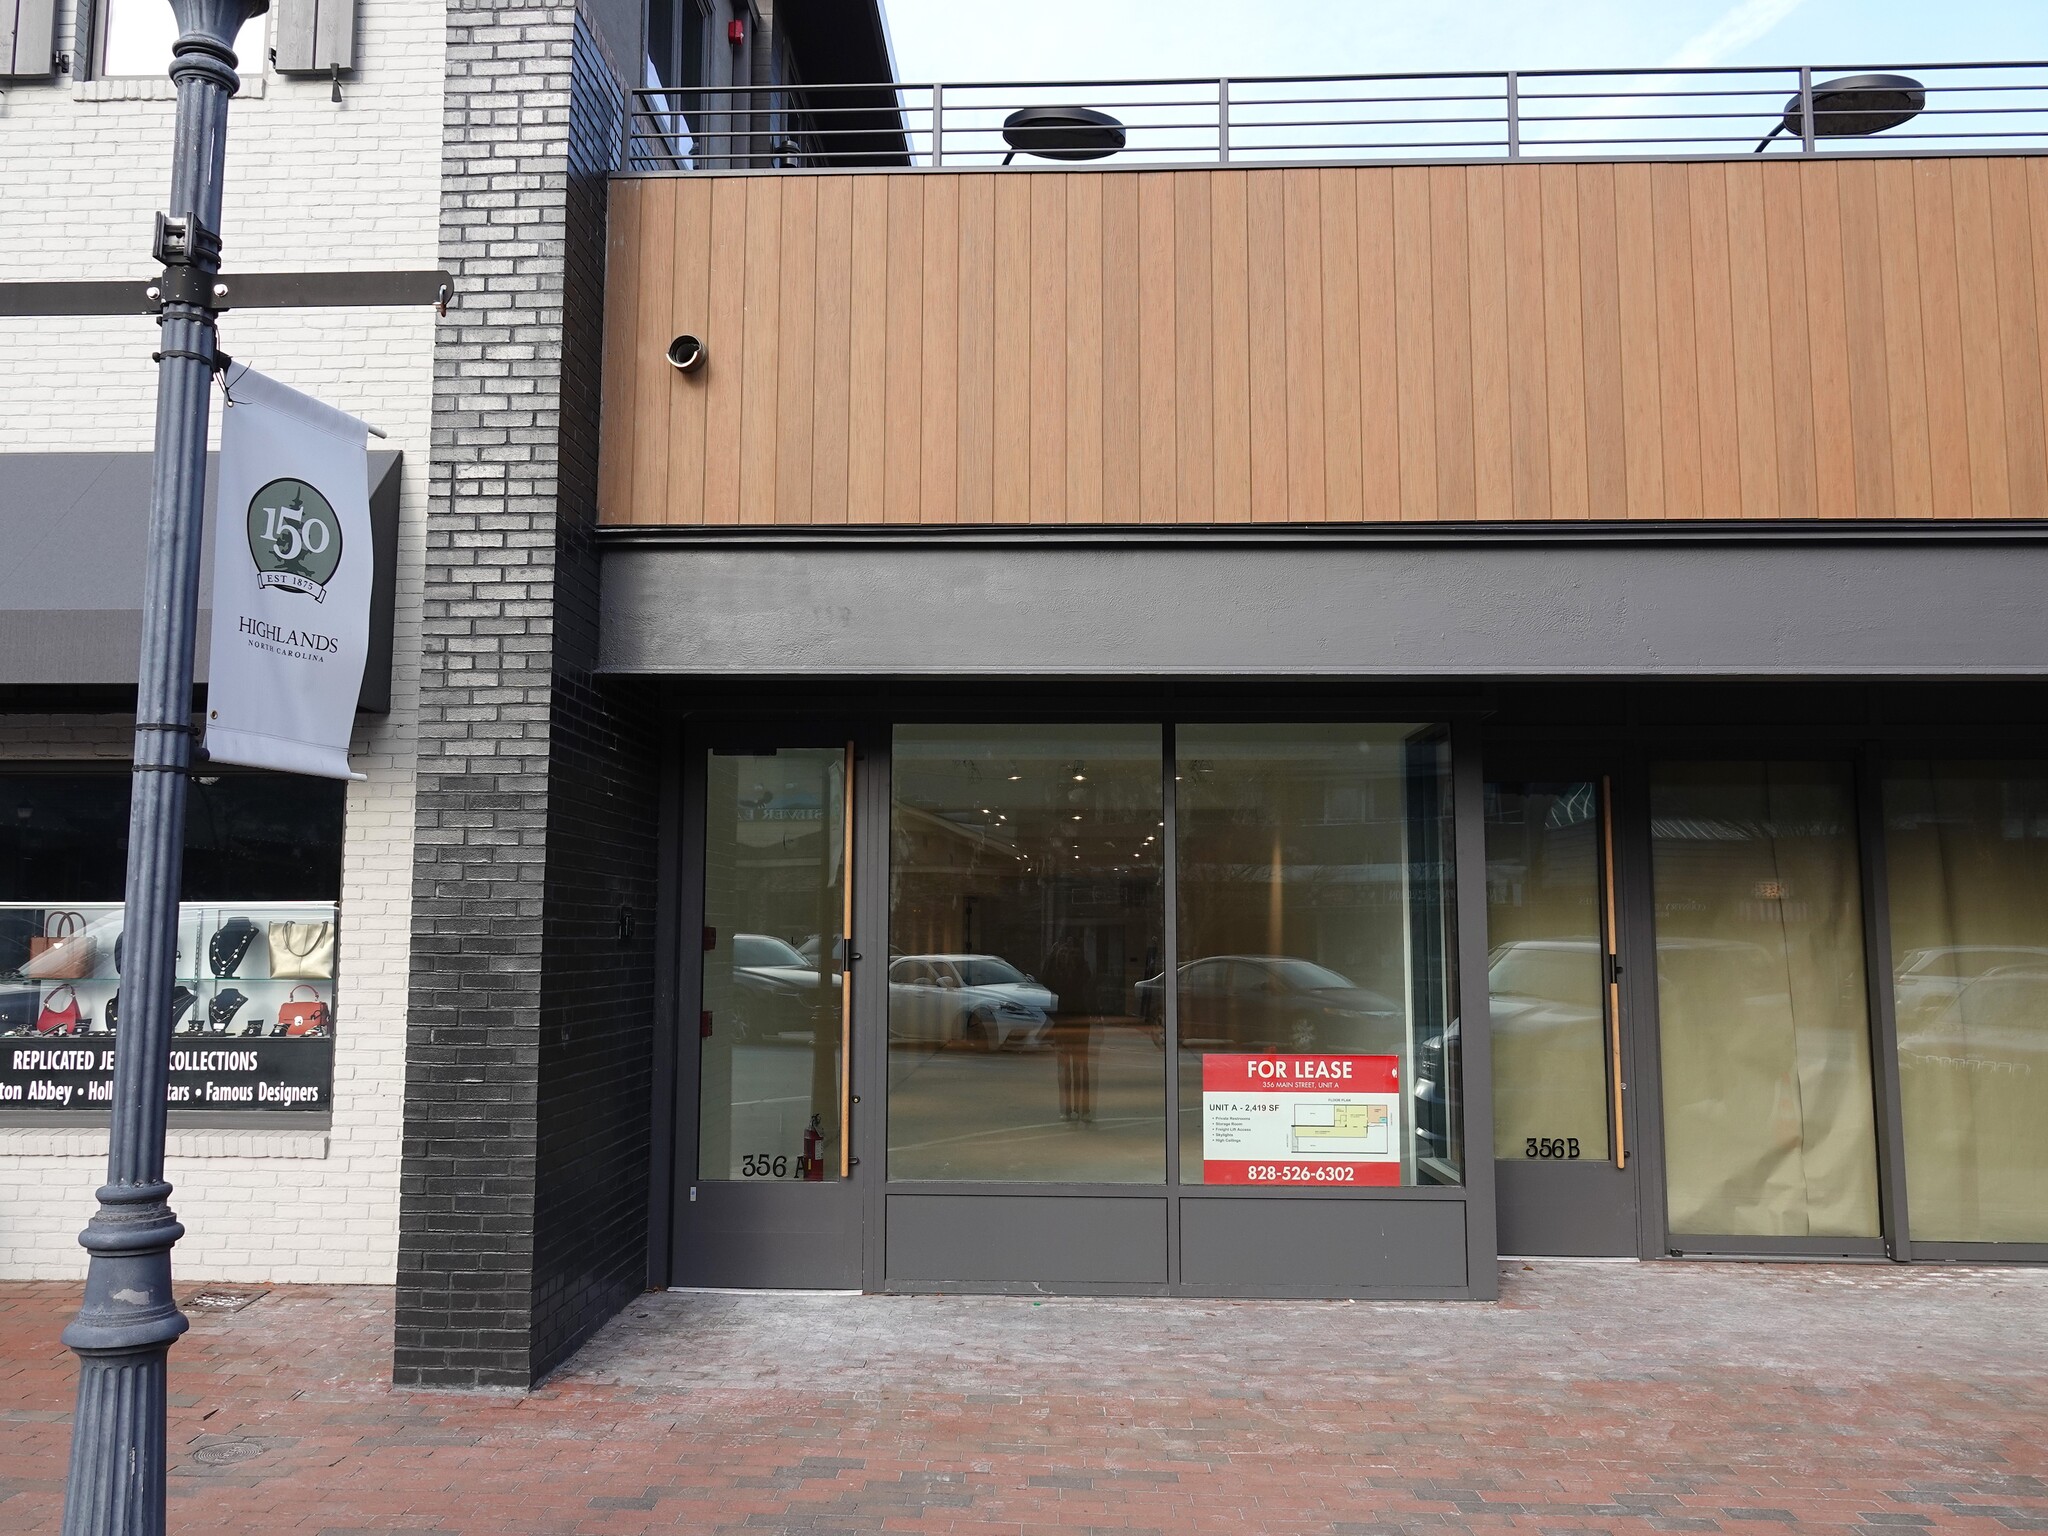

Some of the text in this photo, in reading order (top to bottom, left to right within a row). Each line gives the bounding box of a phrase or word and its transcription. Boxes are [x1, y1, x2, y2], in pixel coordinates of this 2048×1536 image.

[260, 506, 330, 560] 150
[267, 575, 313, 590] EST 1875
[239, 616, 339, 653] HIGHLANDS
[248, 639, 324, 662] NORTH CAROLINA
[13, 1050, 95, 1070] REPLICATED
[169, 1051, 258, 1071] COLLECTIONS
[1247, 1060, 1353, 1079] FOR LEASE
[28, 1080, 73, 1105] Abbey
[206, 1081, 253, 1101] Famous
[258, 1081, 318, 1106] Designers
[1294, 1081, 1317, 1089] STREET,
[1245, 1104, 1267, 1112] 2,419
[742, 1154, 787, 1178] 356
[1247, 1165, 1355, 1181] 828-526-6302
